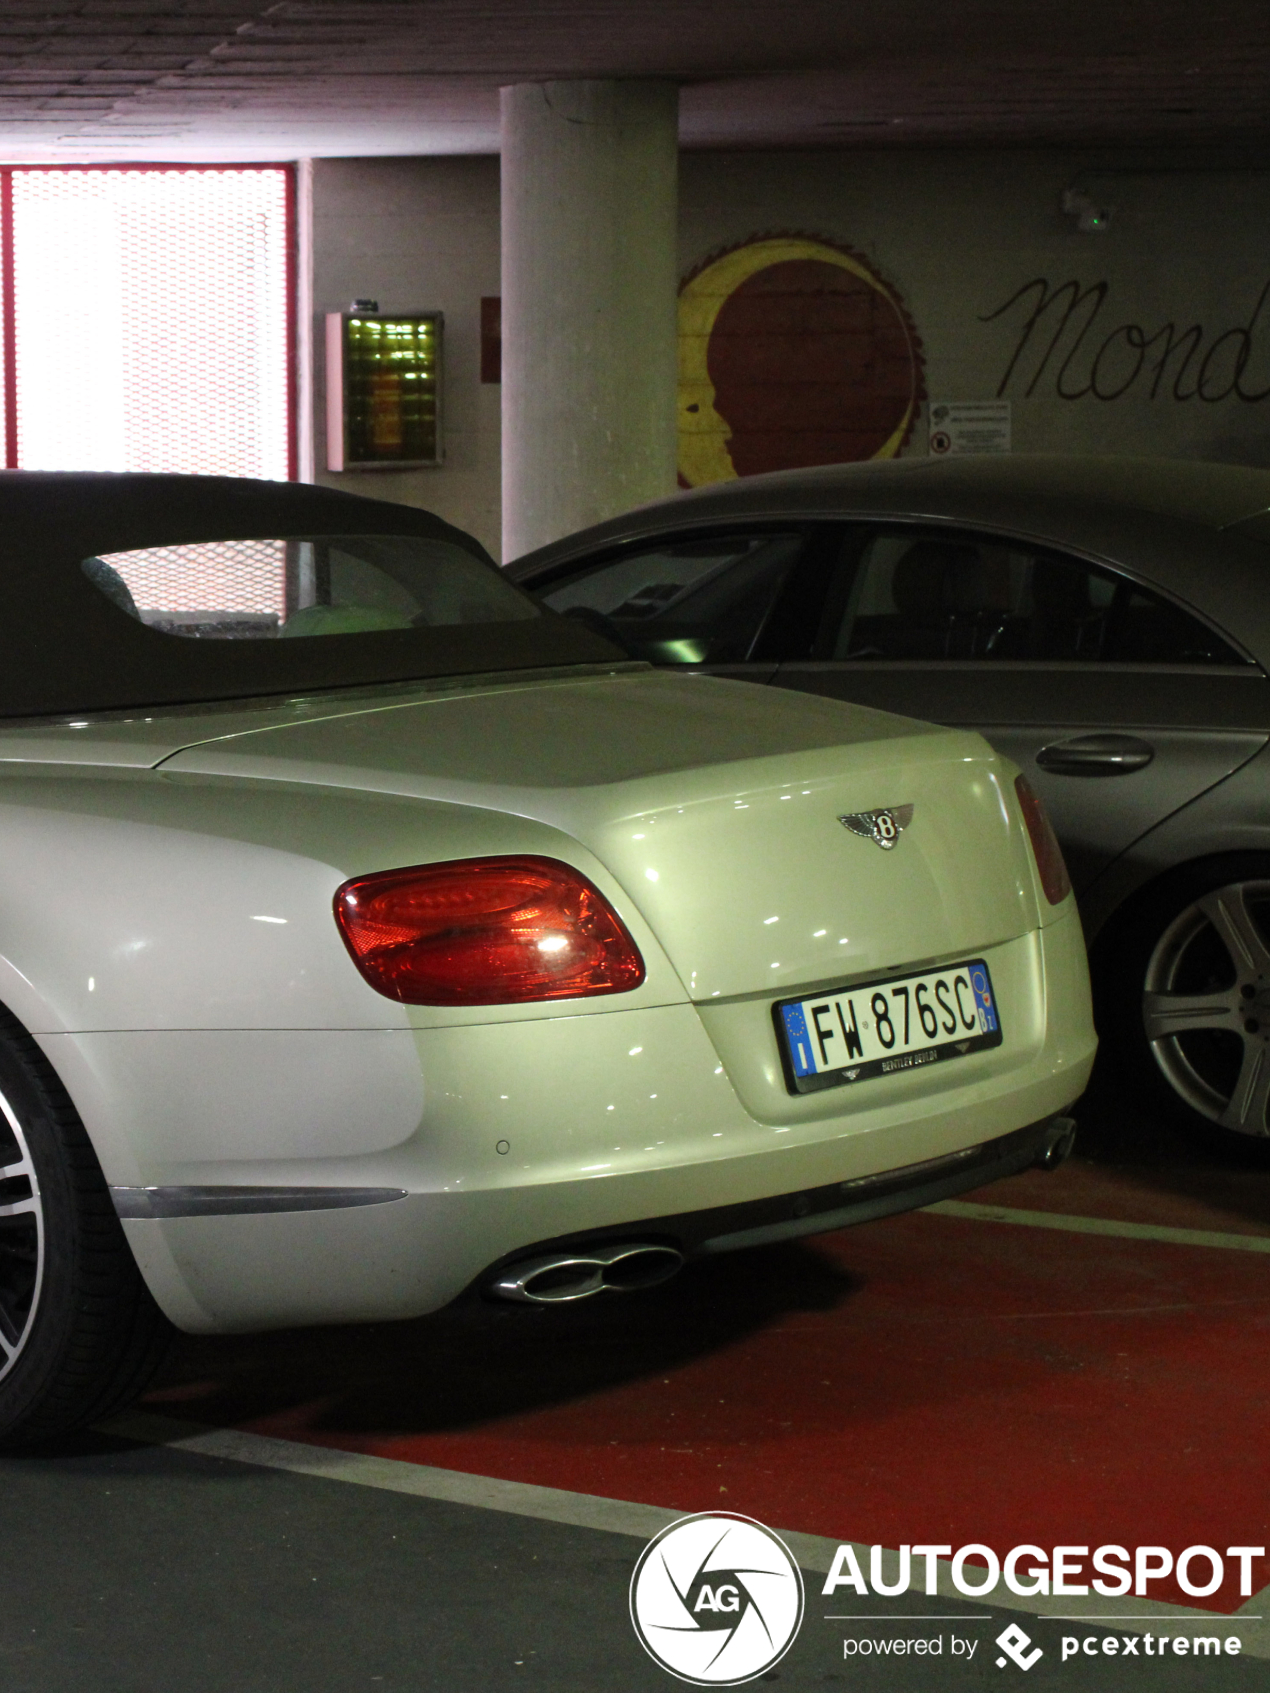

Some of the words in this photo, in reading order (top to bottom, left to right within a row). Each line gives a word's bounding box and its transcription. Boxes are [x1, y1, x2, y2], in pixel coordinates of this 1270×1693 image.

[977, 277, 1270, 403] Mond
[811, 999, 864, 1066] FW
[871, 974, 976, 1050] 876SC
[881, 1055, 913, 1072] BENTLEY
